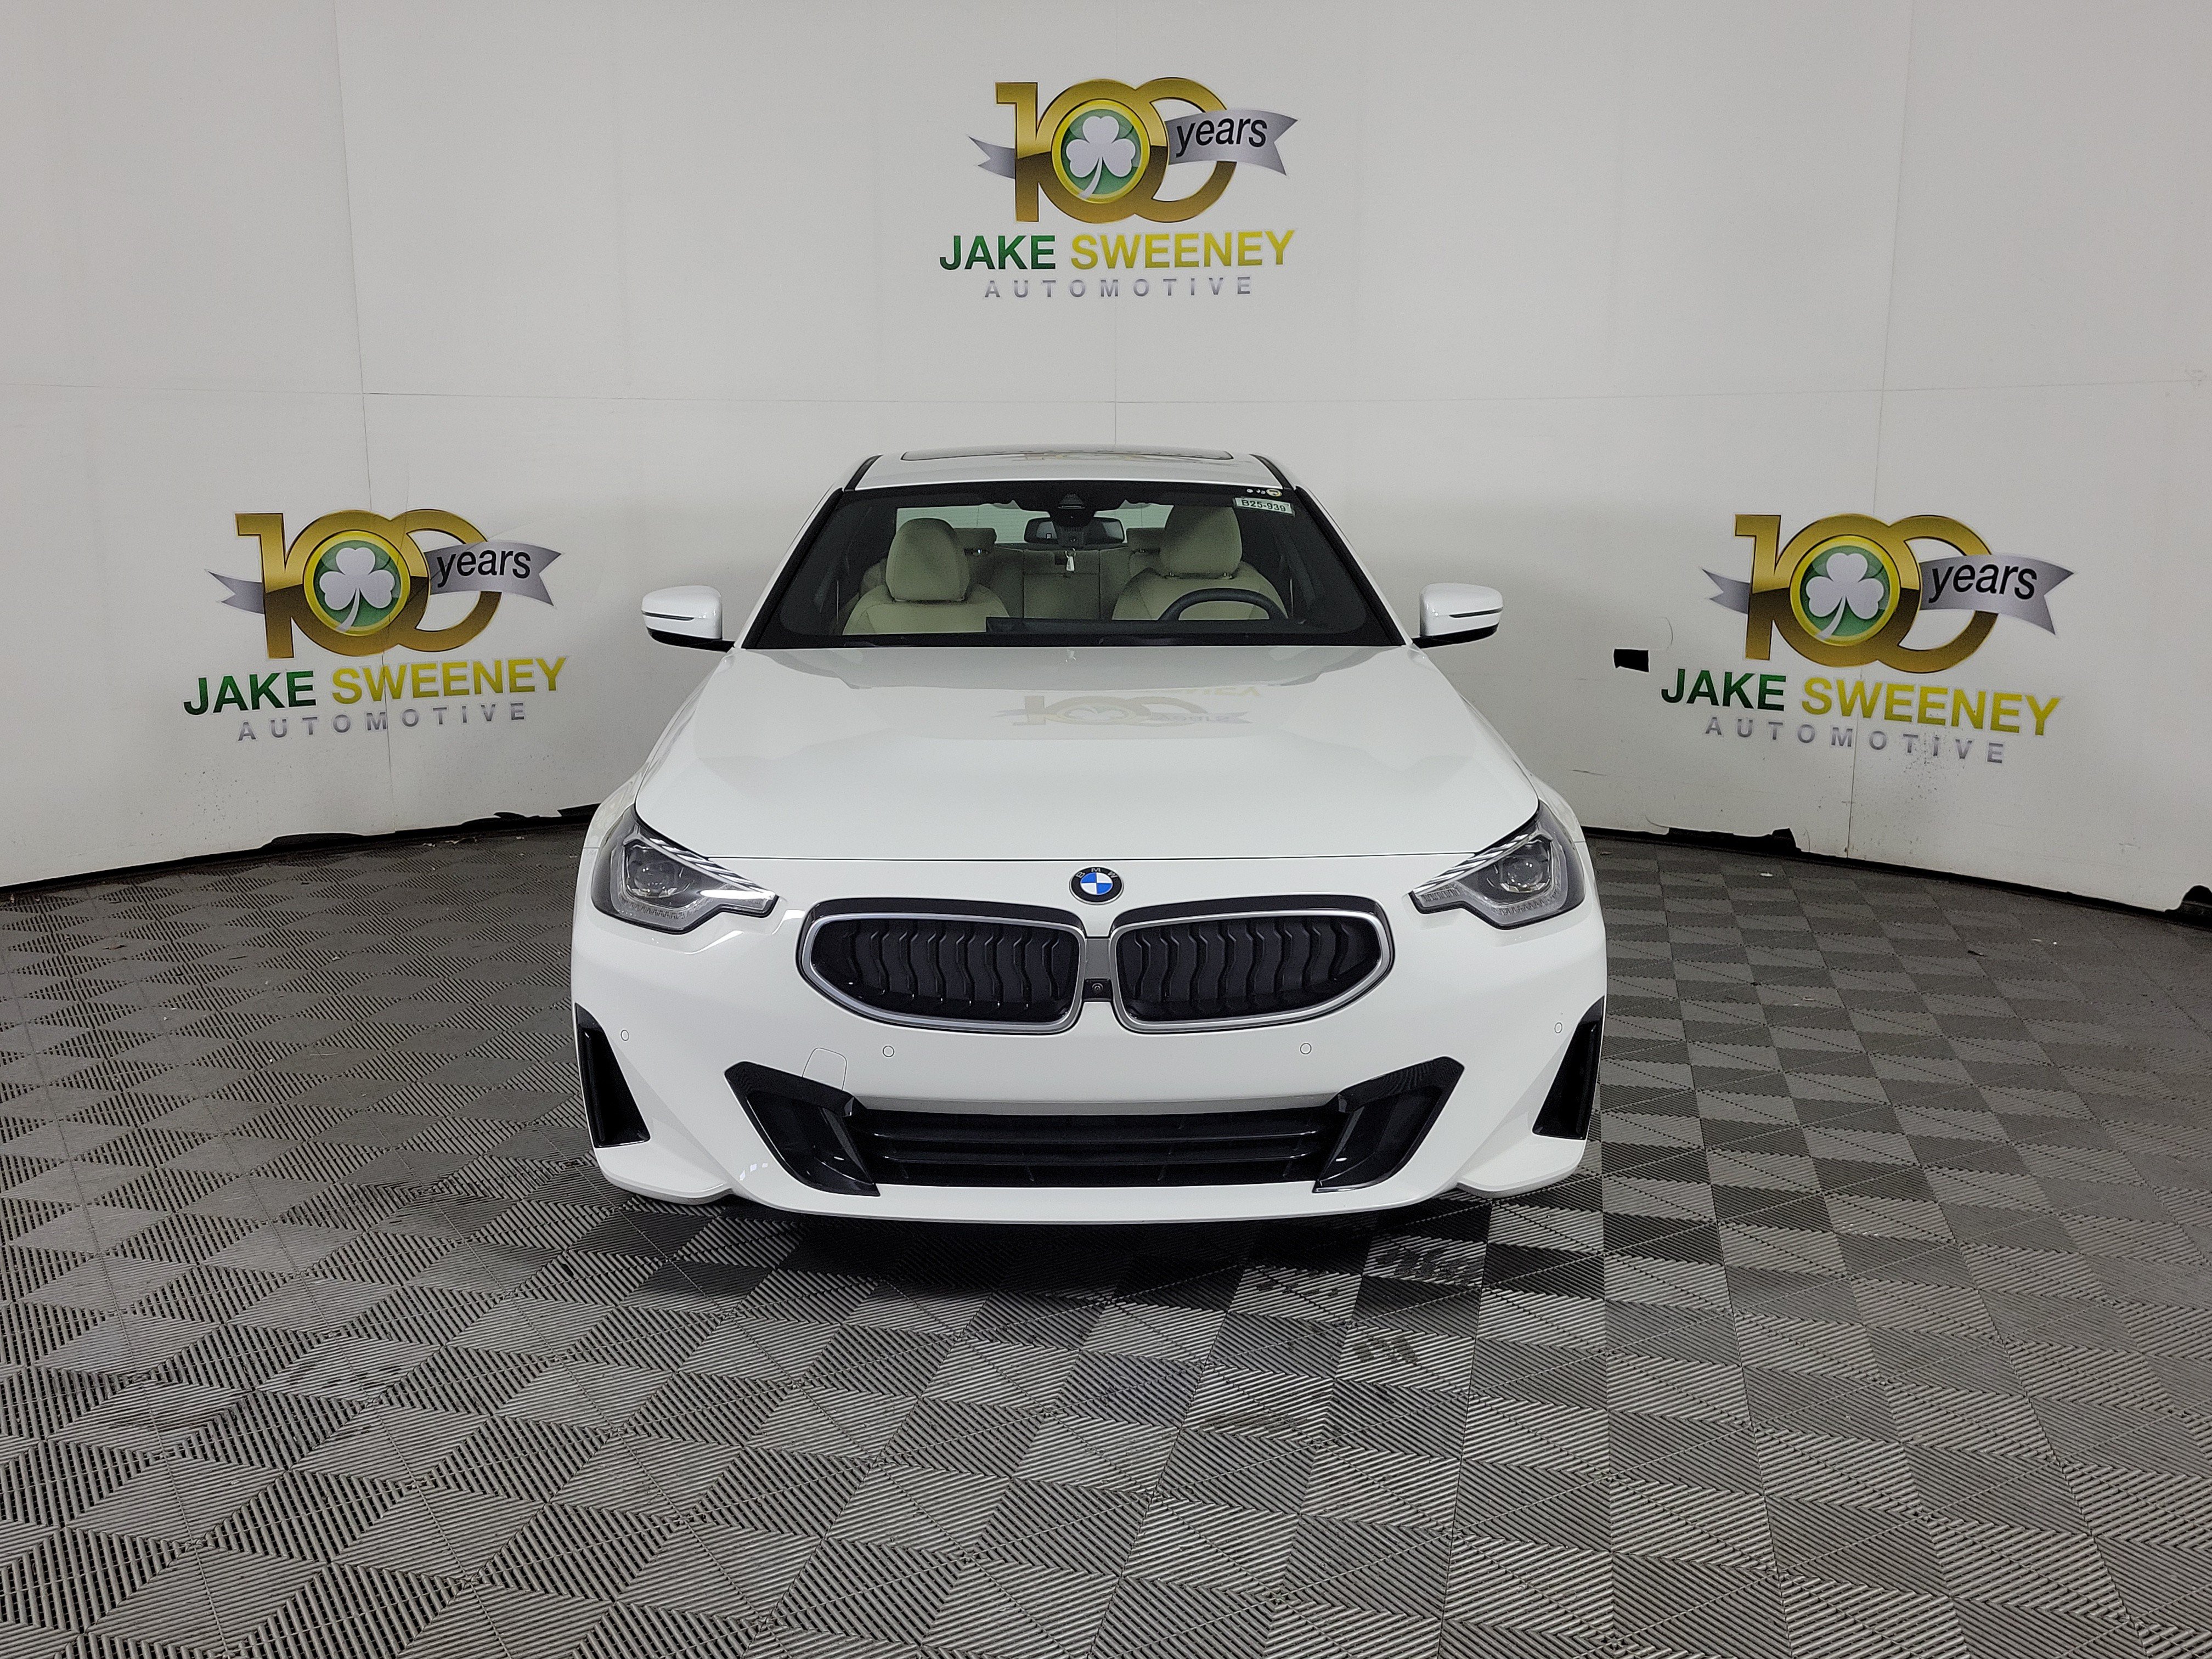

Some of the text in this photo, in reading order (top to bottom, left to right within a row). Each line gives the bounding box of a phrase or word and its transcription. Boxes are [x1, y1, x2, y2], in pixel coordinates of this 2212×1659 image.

[996, 77, 1268, 224] 100 years
[939, 230, 1295, 270] JAKE SWEENEY
[985, 276, 1251, 298] AUTOMOTIVE
[1241, 500, 1286, 511] B25-939
[235, 509, 532, 659] 100 years
[1735, 513, 2038, 674] 100 years
[184, 656, 567, 716] JAKE SWEENEY
[1661, 668, 2062, 736] JAKE SWEENEY
[238, 703, 525, 742] AUTOMOTIVE
[1705, 716, 2004, 764] AUTOMOTIVE
[1076, 867, 1118, 878] BMW
